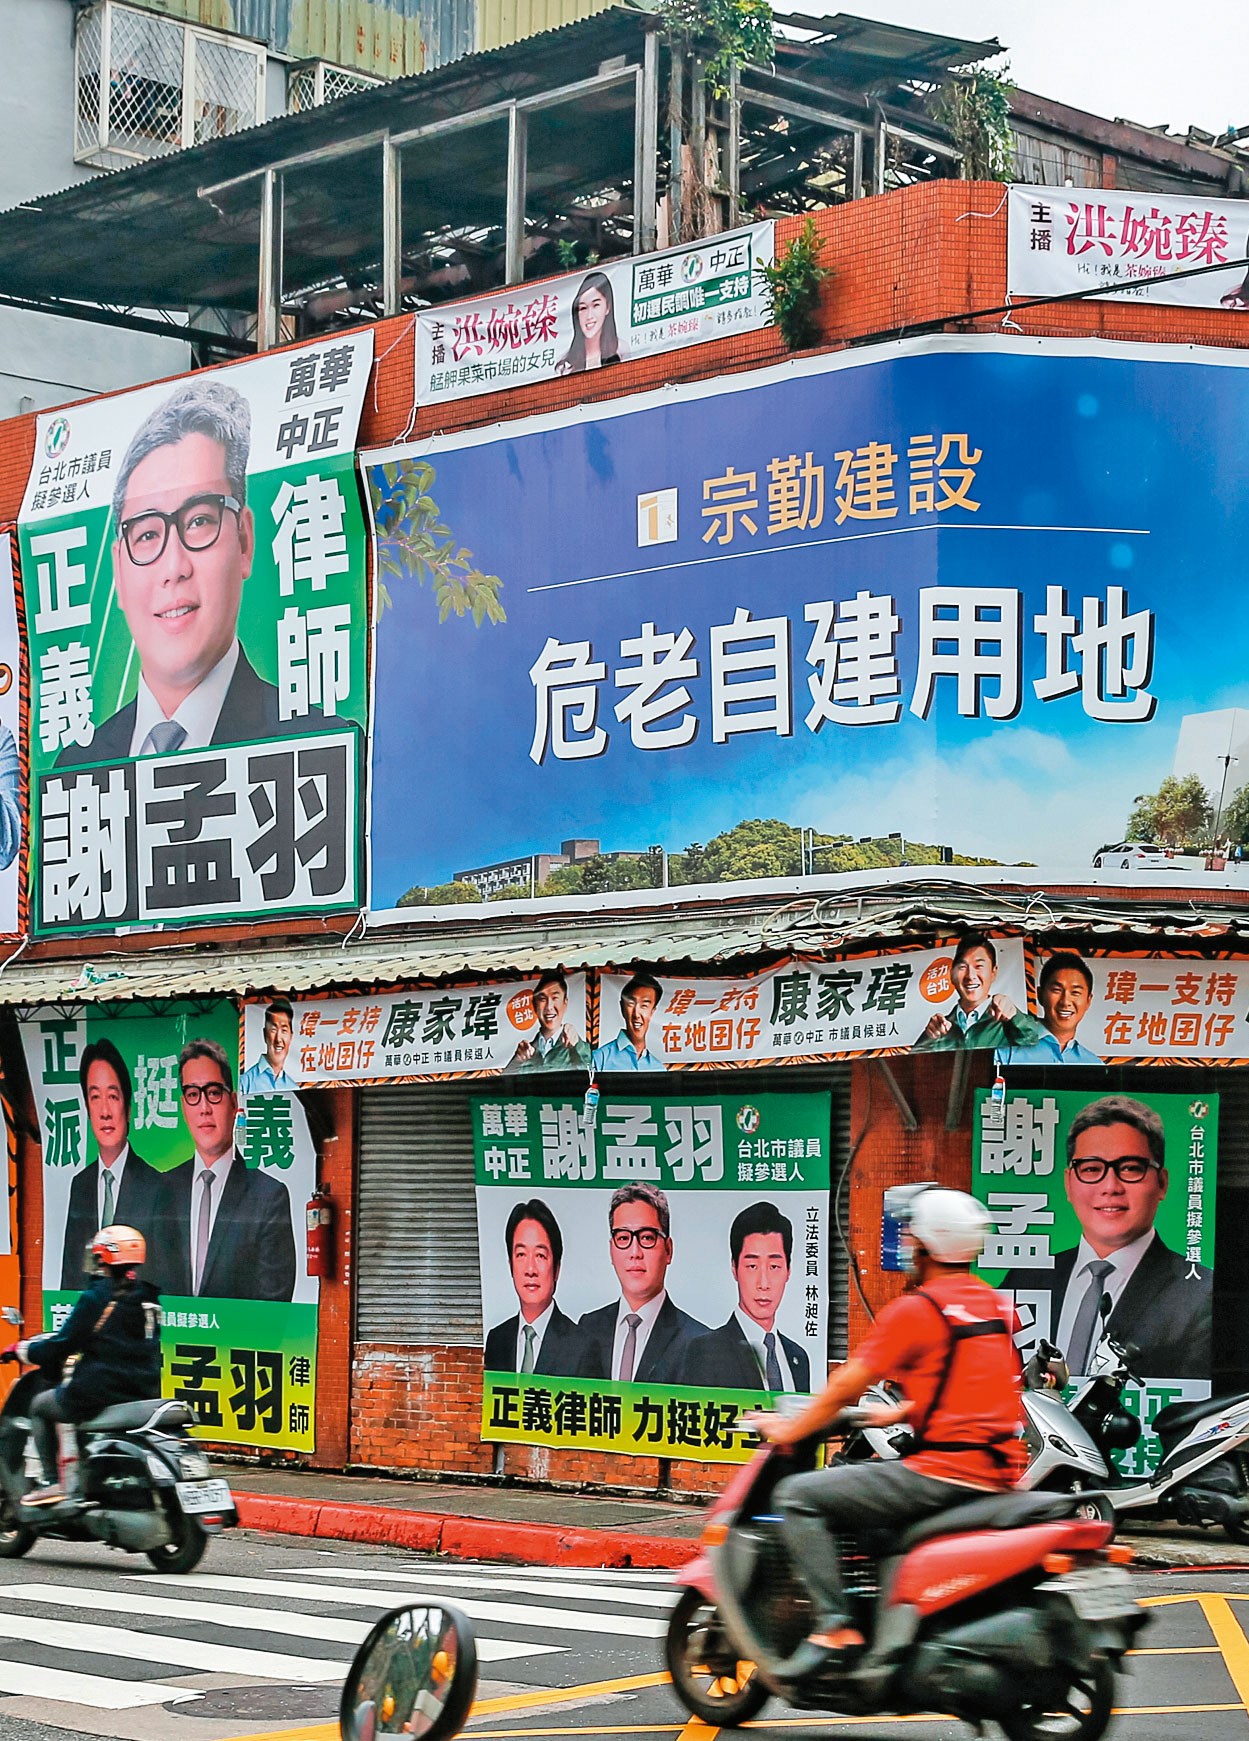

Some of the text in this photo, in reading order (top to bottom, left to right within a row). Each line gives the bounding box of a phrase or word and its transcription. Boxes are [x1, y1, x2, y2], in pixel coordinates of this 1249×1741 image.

[1031, 202, 1053, 251] 主播
[1064, 202, 1229, 264] 洪婉臻
[638, 244, 746, 293] 萬華 中正
[633, 276, 749, 323] 初選民調唯一支持
[431, 322, 446, 366] 主播
[451, 295, 559, 362] 洪婉臻
[285, 345, 355, 402] 萬華
[430, 348, 556, 392] 艋舺果菜市場的女兒
[276, 406, 344, 459] 中正
[38, 449, 112, 484] 台北市議員
[701, 433, 984, 545] 宗勤建設
[31, 480, 91, 512] 擬參選人
[270, 474, 350, 721] 律師
[31, 525, 95, 752] 正義
[528, 585, 1156, 766] 危老自建用地
[41, 745, 348, 923] 謝孟羽
[769, 961, 914, 1027] 康家瑋
[926, 965, 949, 980] 活力
[926, 980, 950, 996] 台北
[1103, 970, 1239, 1008] 瑋一支持
[299, 1005, 382, 1038] 瑋一支持
[380, 992, 504, 1049] 康家瑋
[511, 996, 531, 1010] 活力
[514, 1009, 535, 1025] 台北
[664, 985, 760, 1017] 瑋一支持
[412, 1052, 430, 1065] 中正
[805, 1029, 825, 1044] 中正
[40, 1020, 82, 1168] 正派
[134, 1053, 180, 1132] 挺
[243, 1094, 296, 1171] 義
[480, 1104, 528, 1137] 萬華
[539, 1104, 725, 1183] 謝孟羽
[484, 1146, 532, 1180] 中正
[737, 1138, 822, 1159] 台北市議員
[737, 1161, 806, 1183] 擬參選人
[1184, 1125, 1206, 1280] 台北市議員擬參選人
[804, 1205, 820, 1337] 立法委員 林昶佐
[161, 1343, 285, 1437] 孟羽
[289, 1356, 311, 1435] 律師
[489, 1386, 768, 1450] 正義律師 力挺好
